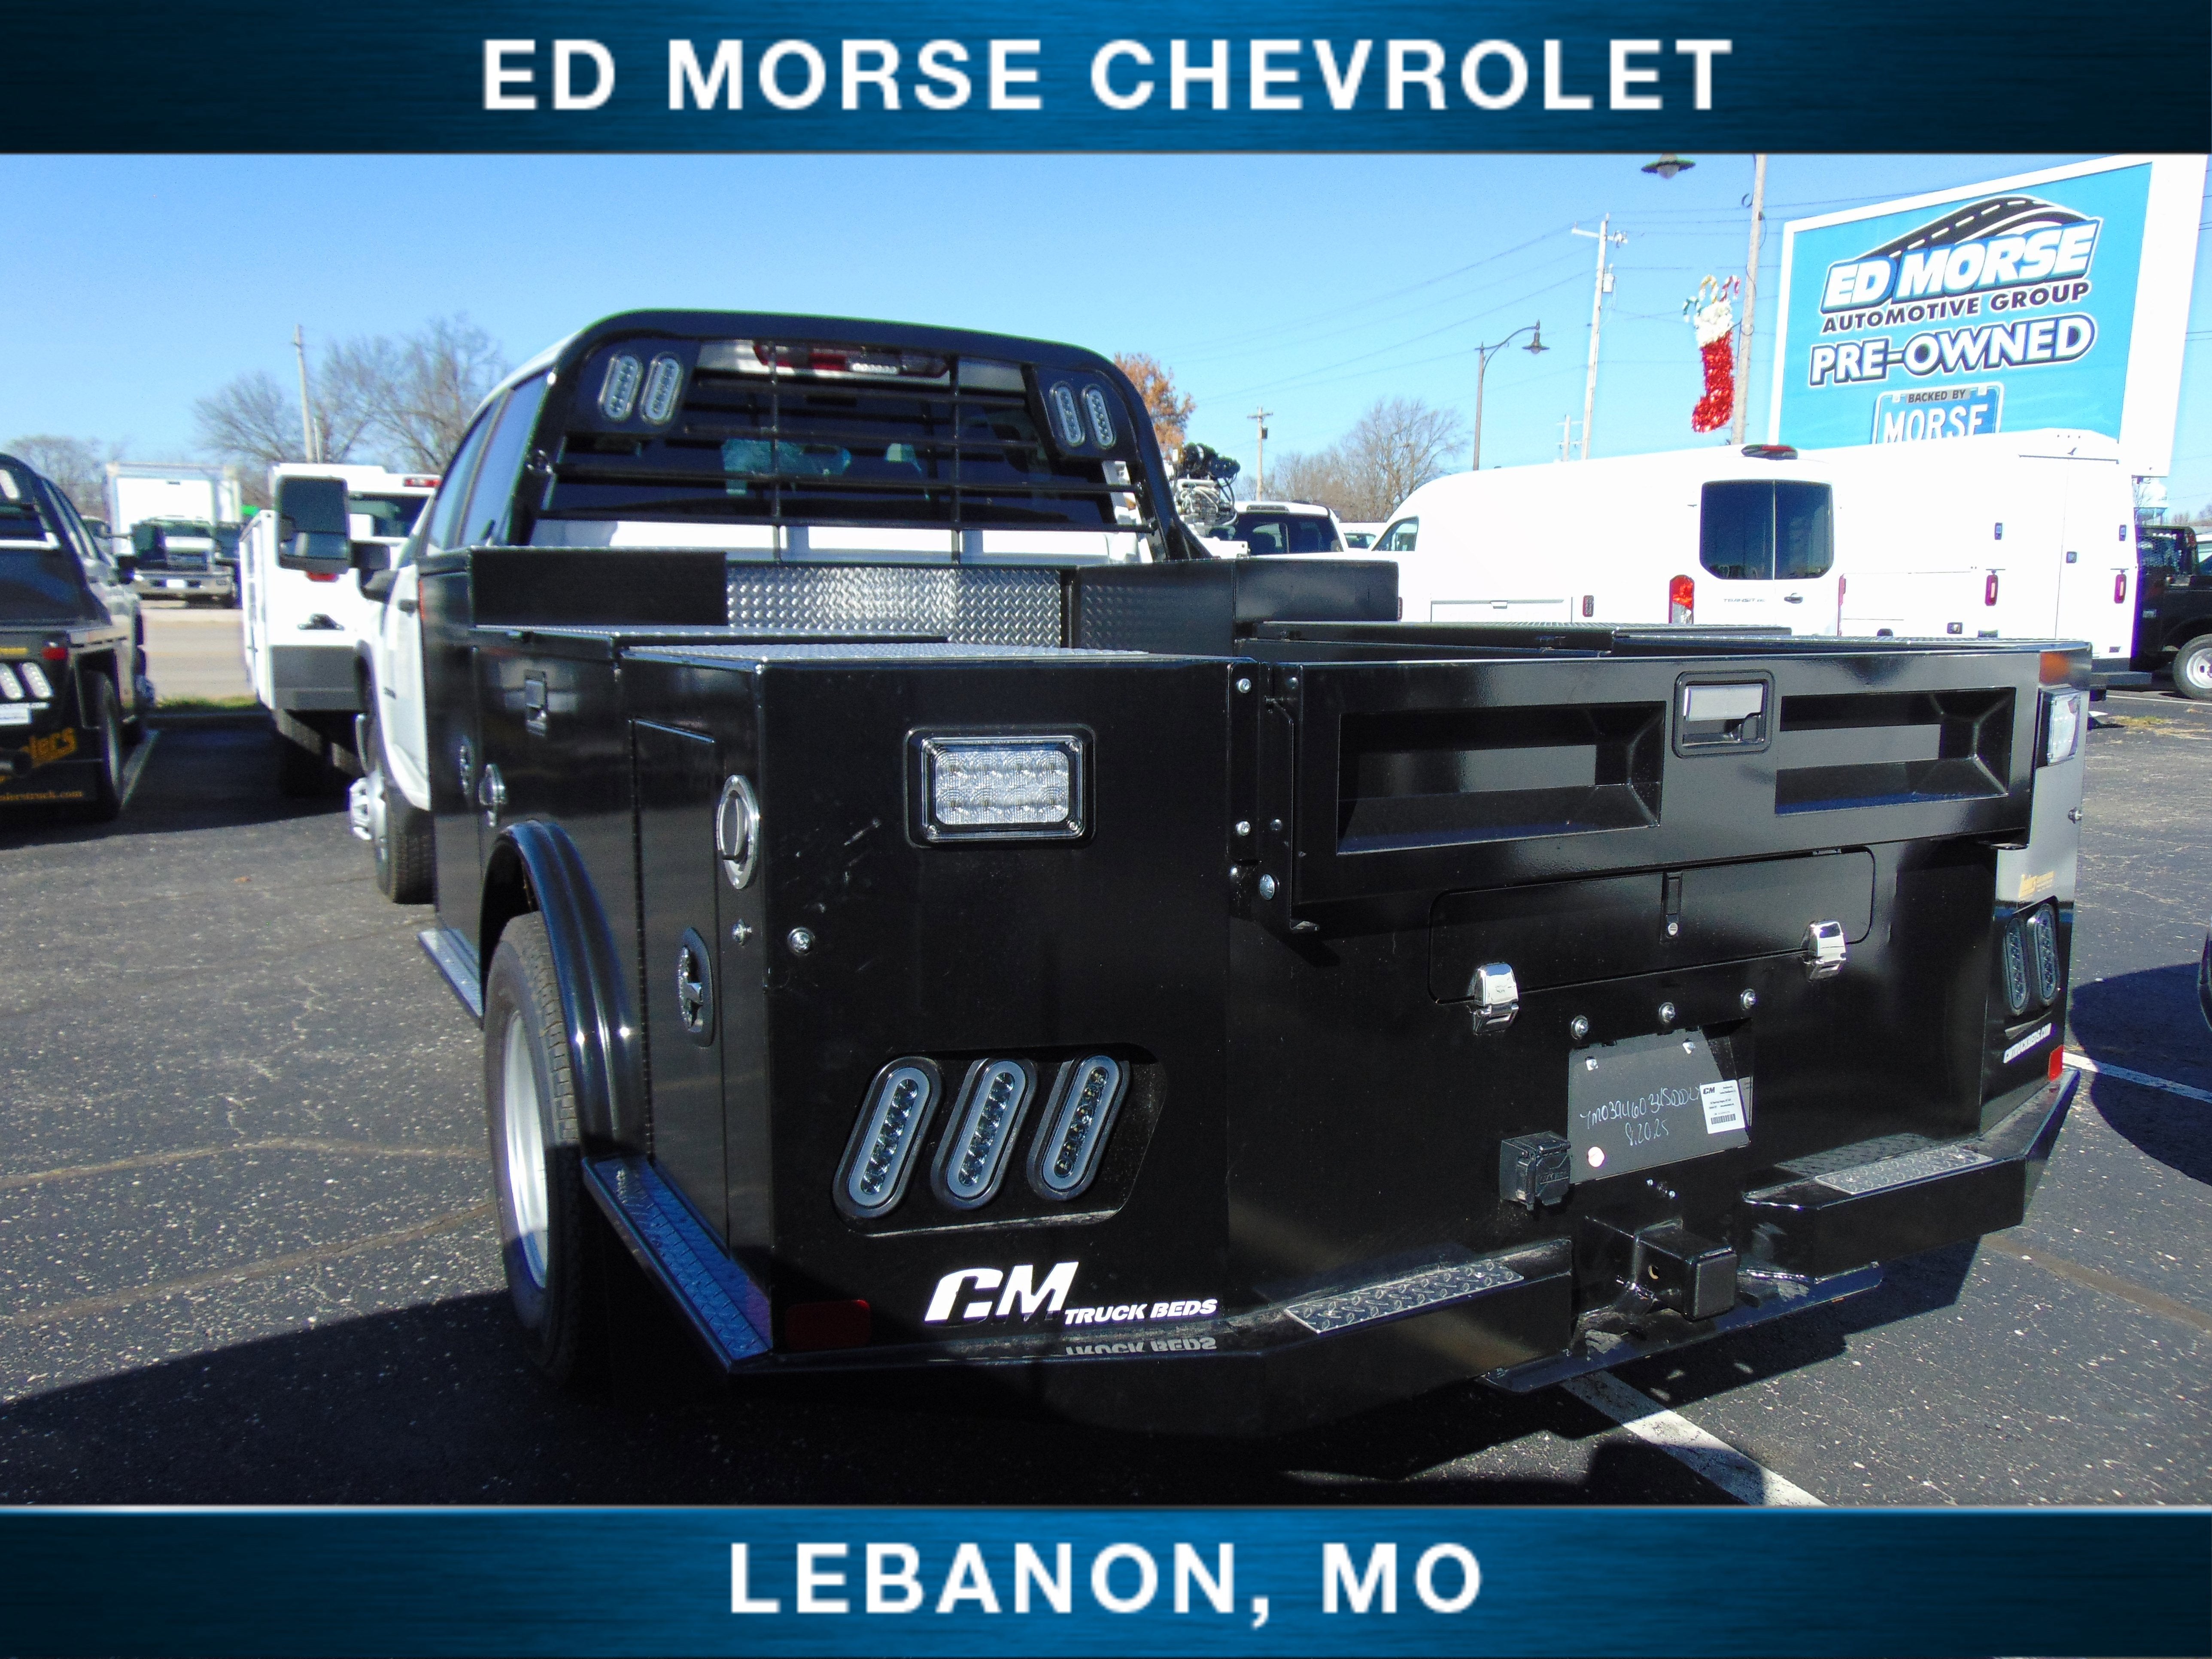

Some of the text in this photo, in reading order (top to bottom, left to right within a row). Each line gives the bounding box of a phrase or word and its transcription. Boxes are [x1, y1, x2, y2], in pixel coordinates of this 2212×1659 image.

[1822, 222, 2098, 310] ED MORSE
[1822, 282, 2090, 333] AUTOMOTIVE GROUP
[1811, 317, 2094, 385] PRE-OWNED
[1908, 389, 1966, 403] BACKED BY
[1883, 403, 1988, 443] MORSE
[924, 1261, 1079, 1322] CM
[1064, 1298, 1218, 1325] TRUCK BEDS
